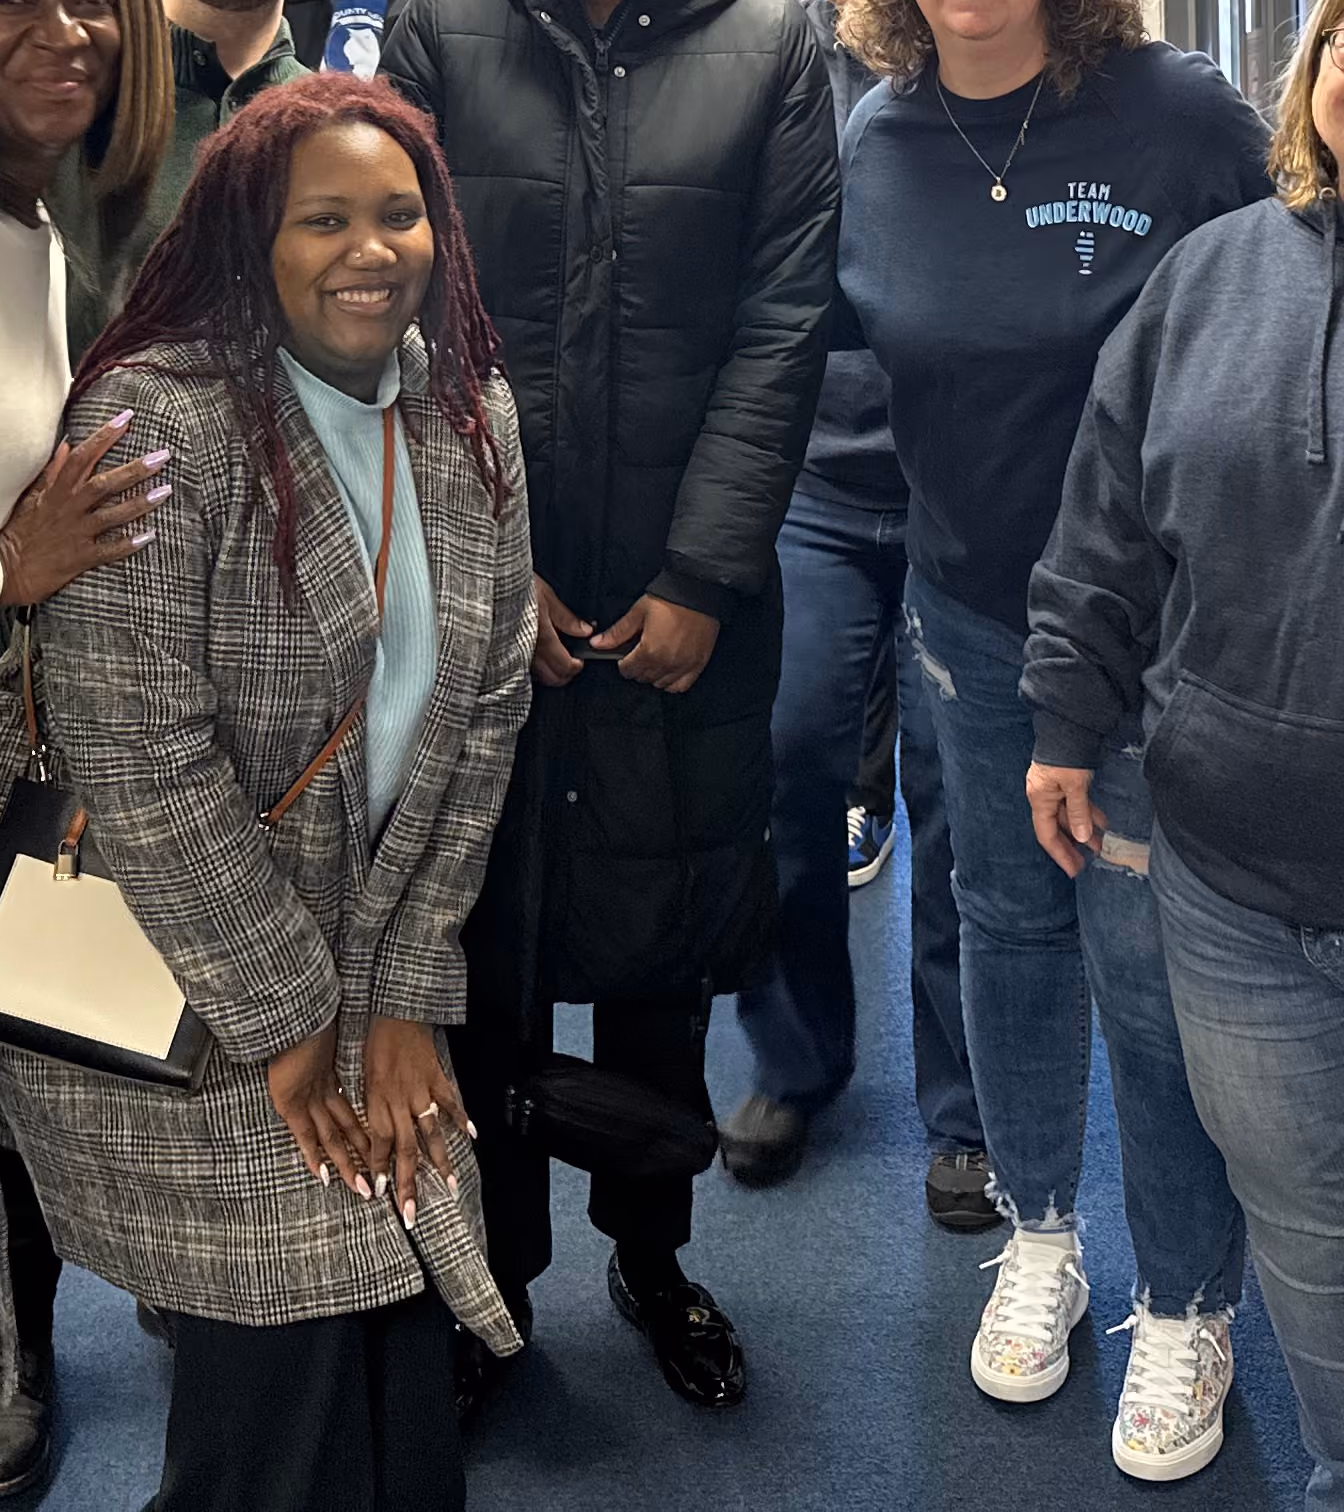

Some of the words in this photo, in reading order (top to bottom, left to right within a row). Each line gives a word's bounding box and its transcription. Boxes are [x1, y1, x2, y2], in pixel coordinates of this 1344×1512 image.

[332, 8, 367, 19] OUNTY
[1067, 182, 1111, 200] TEAM
[1025, 200, 1153, 236] UNDERWOOD
